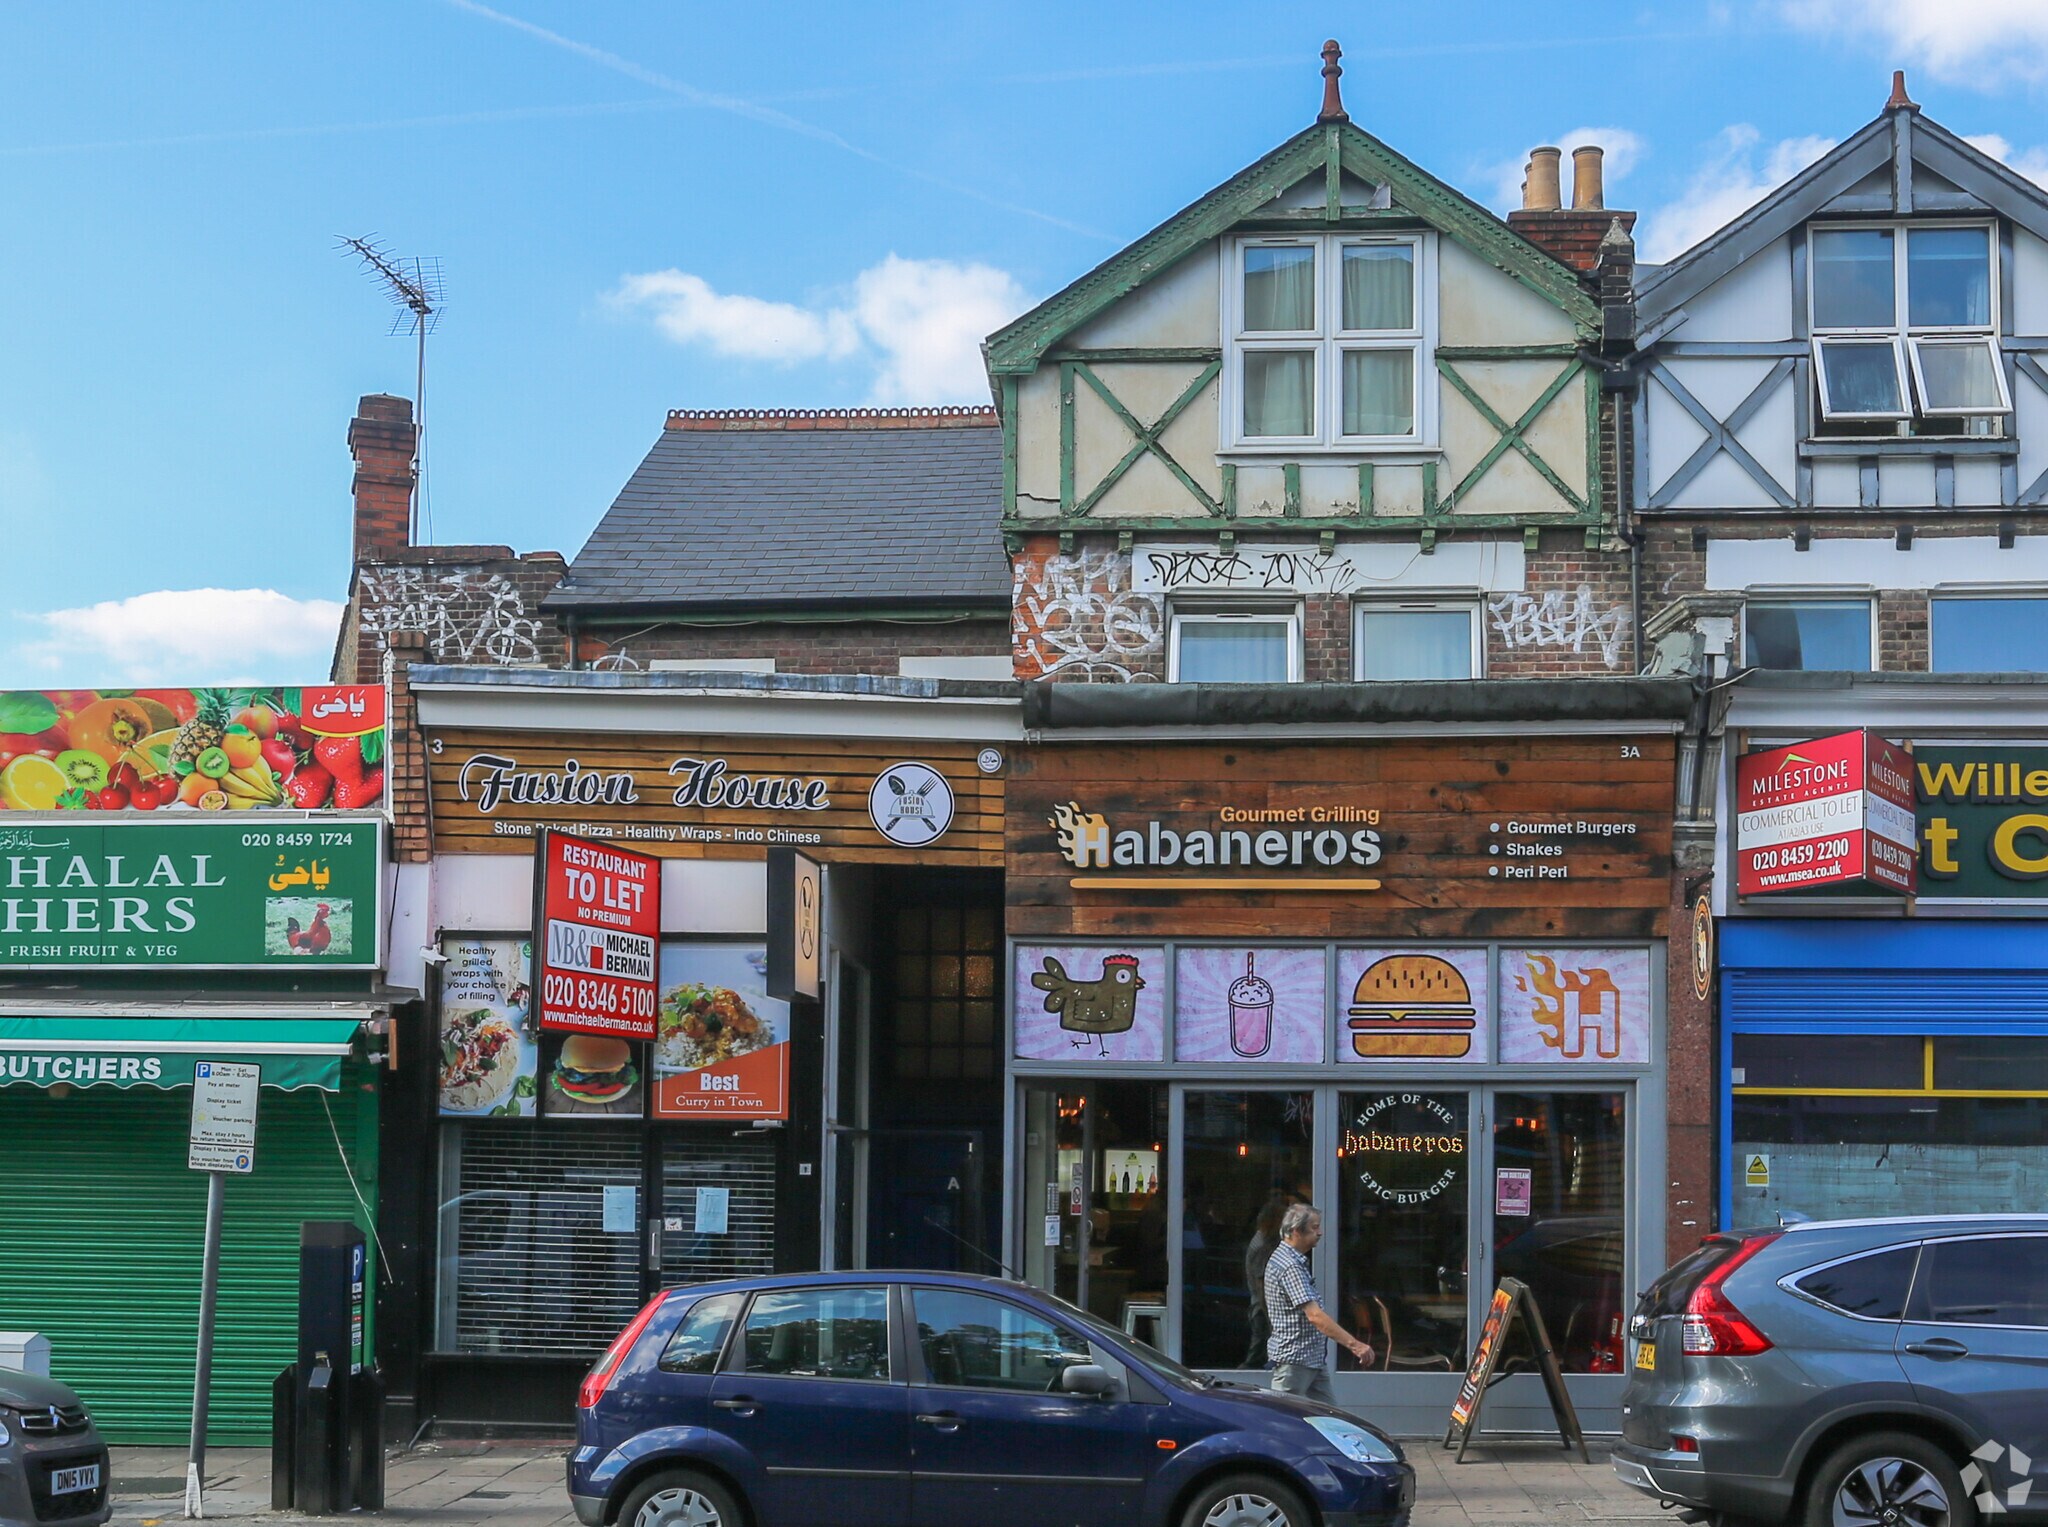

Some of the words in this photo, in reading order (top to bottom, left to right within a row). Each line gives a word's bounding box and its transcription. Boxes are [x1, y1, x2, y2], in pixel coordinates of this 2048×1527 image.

[432, 738, 443, 754] 3
[1620, 746, 1640, 758] 3A
[459, 753, 639, 813] Fusion
[668, 758, 830, 811] House
[1752, 760, 1848, 795] MILESTONE
[1871, 761, 1909, 796] MILESTONE
[1753, 793, 1794, 806] ESTATE
[1804, 781, 1848, 796] AGENTS
[1220, 806, 1305, 823] Gourmet
[1310, 806, 1380, 825] Grilling
[1742, 804, 1818, 832] COMMERCIAL
[1822, 800, 1837, 817] TO
[1840, 796, 1858, 814] LET
[242, 834, 271, 846] 020
[276, 833, 313, 846] 8459
[320, 832, 353, 845] 1724
[494, 822, 532, 835] Stone
[537, 823, 577, 835] ked
[579, 824, 613, 837] Pizza
[625, 826, 676, 841] Healthy
[680, 827, 722, 843] Wraps
[734, 829, 763, 842] Indo
[767, 829, 821, 844] Chinese
[1507, 821, 1573, 834] Gourmet
[1576, 821, 1636, 836] Burgers
[1810, 822, 1824, 834] USE
[1075, 821, 1382, 867] Habaneros
[1506, 843, 1563, 856] Shakes
[1753, 851, 1777, 870] 020
[1781, 844, 1813, 866] 8459
[1817, 838, 1849, 860] 2200
[6, 854, 227, 888] HALAL
[563, 844, 646, 879] RESTAURANT
[1505, 865, 1534, 878] Peri
[1539, 865, 1568, 878] Peri
[1760, 861, 1841, 886] www.msea.co.uk
[565, 868, 596, 903] TO
[604, 876, 645, 912] LET
[1, 897, 196, 933] HERS
[578, 906, 590, 919] NO
[593, 909, 631, 926] PREMIUM
[10, 945, 61, 957] FRESH
[69, 945, 119, 957] FRUIT
[126, 946, 137, 957] &
[144, 945, 177, 957] VEG
[459, 947, 496, 956] Healthy
[606, 934, 650, 957] MICHAEL
[462, 958, 493, 967] grilled
[606, 955, 650, 976] BERMAN
[451, 970, 480, 978] wraps
[472, 981, 506, 989] choice
[458, 992, 467, 1000] of
[470, 992, 495, 1001] filling
[544, 974, 574, 1007] 020
[578, 979, 617, 1012] 8346
[621, 984, 654, 1018] 5100
[544, 1010, 653, 1033] www.michaelberman.co.uk
[200, 1065, 208, 1076] P
[700, 1073, 739, 1091] Best
[676, 1095, 710, 1109] Curry
[714, 1097, 725, 1106] in
[729, 1097, 763, 1107] Town
[1357, 1095, 1397, 1126] HOME
[1402, 1094, 1421, 1104] OF
[1427, 1099, 1453, 1123] THE
[1345, 1129, 1463, 1154] habaneros
[1360, 1171, 1391, 1200] EPIC
[1398, 1169, 1456, 1203] BURGER
[353, 1249, 360, 1276] P
